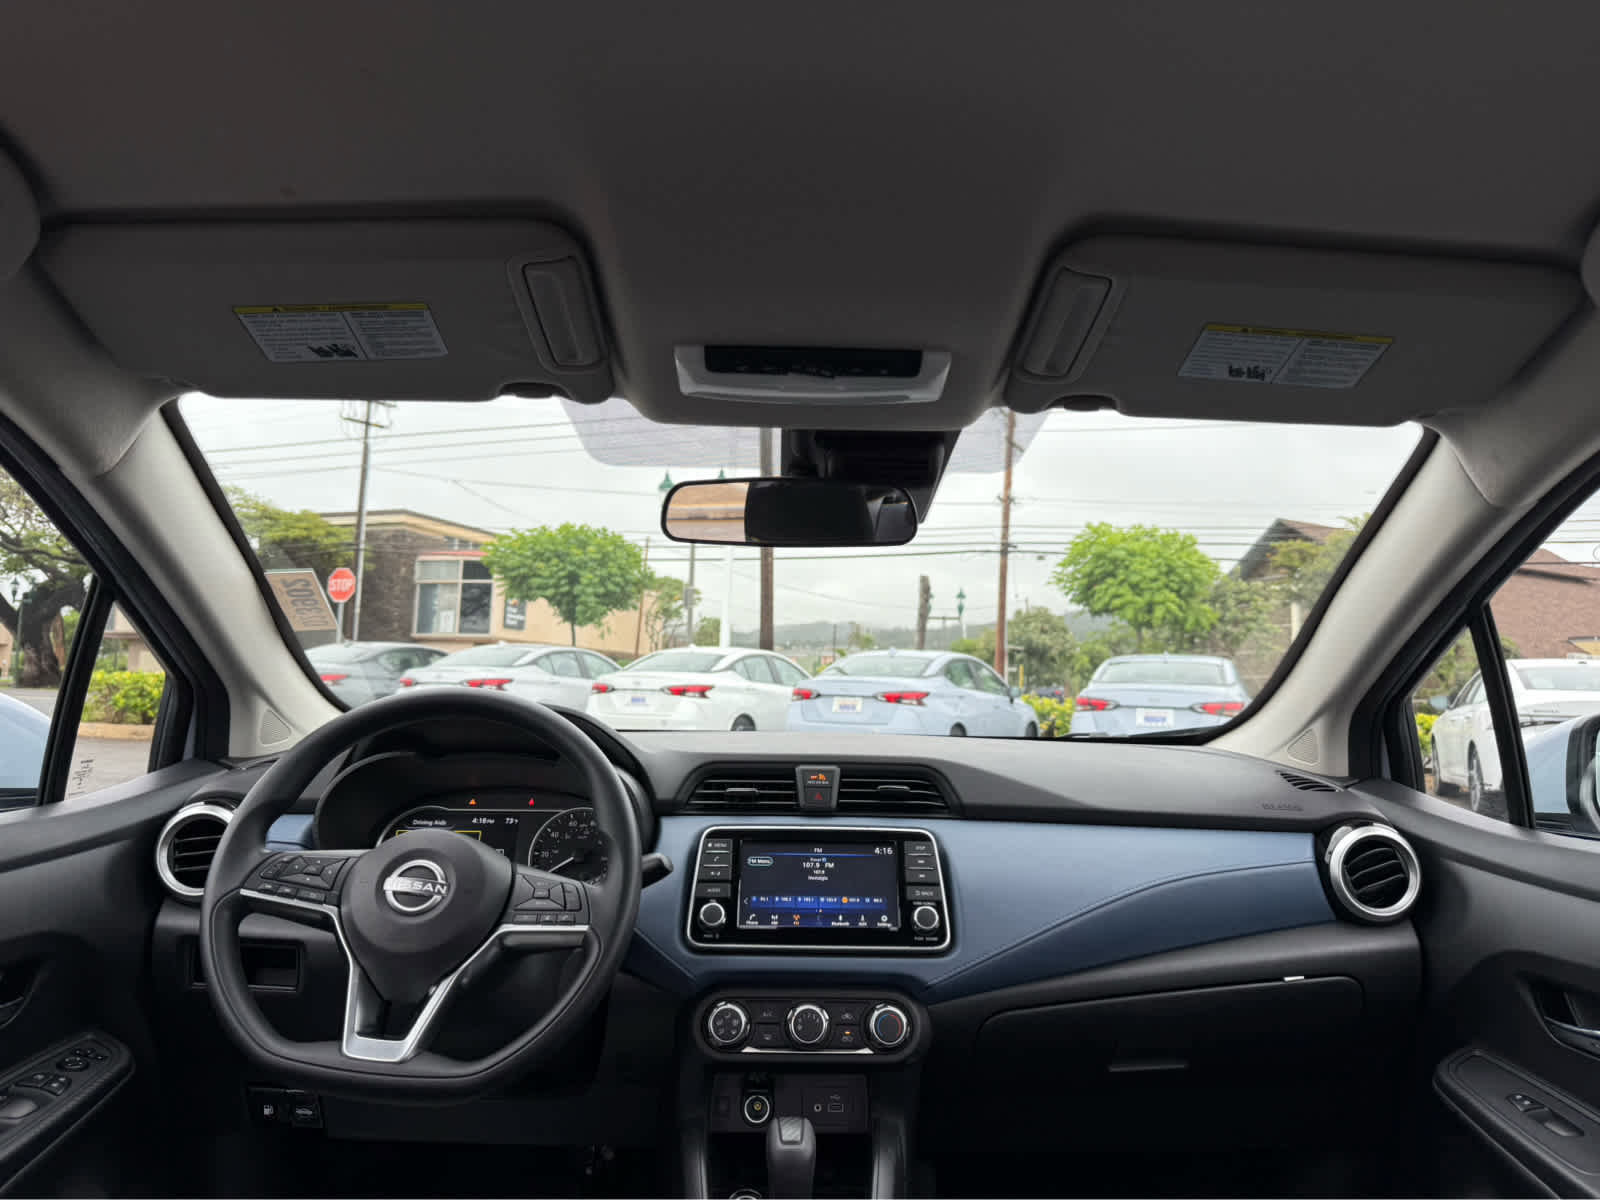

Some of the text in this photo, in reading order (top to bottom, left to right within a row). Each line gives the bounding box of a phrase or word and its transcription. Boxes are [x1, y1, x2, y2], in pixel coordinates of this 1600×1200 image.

[329, 578, 353, 593] STOP
[412, 818, 434, 827] Driving
[874, 847, 893, 855] 4:16
[384, 879, 448, 895] NISSAN
